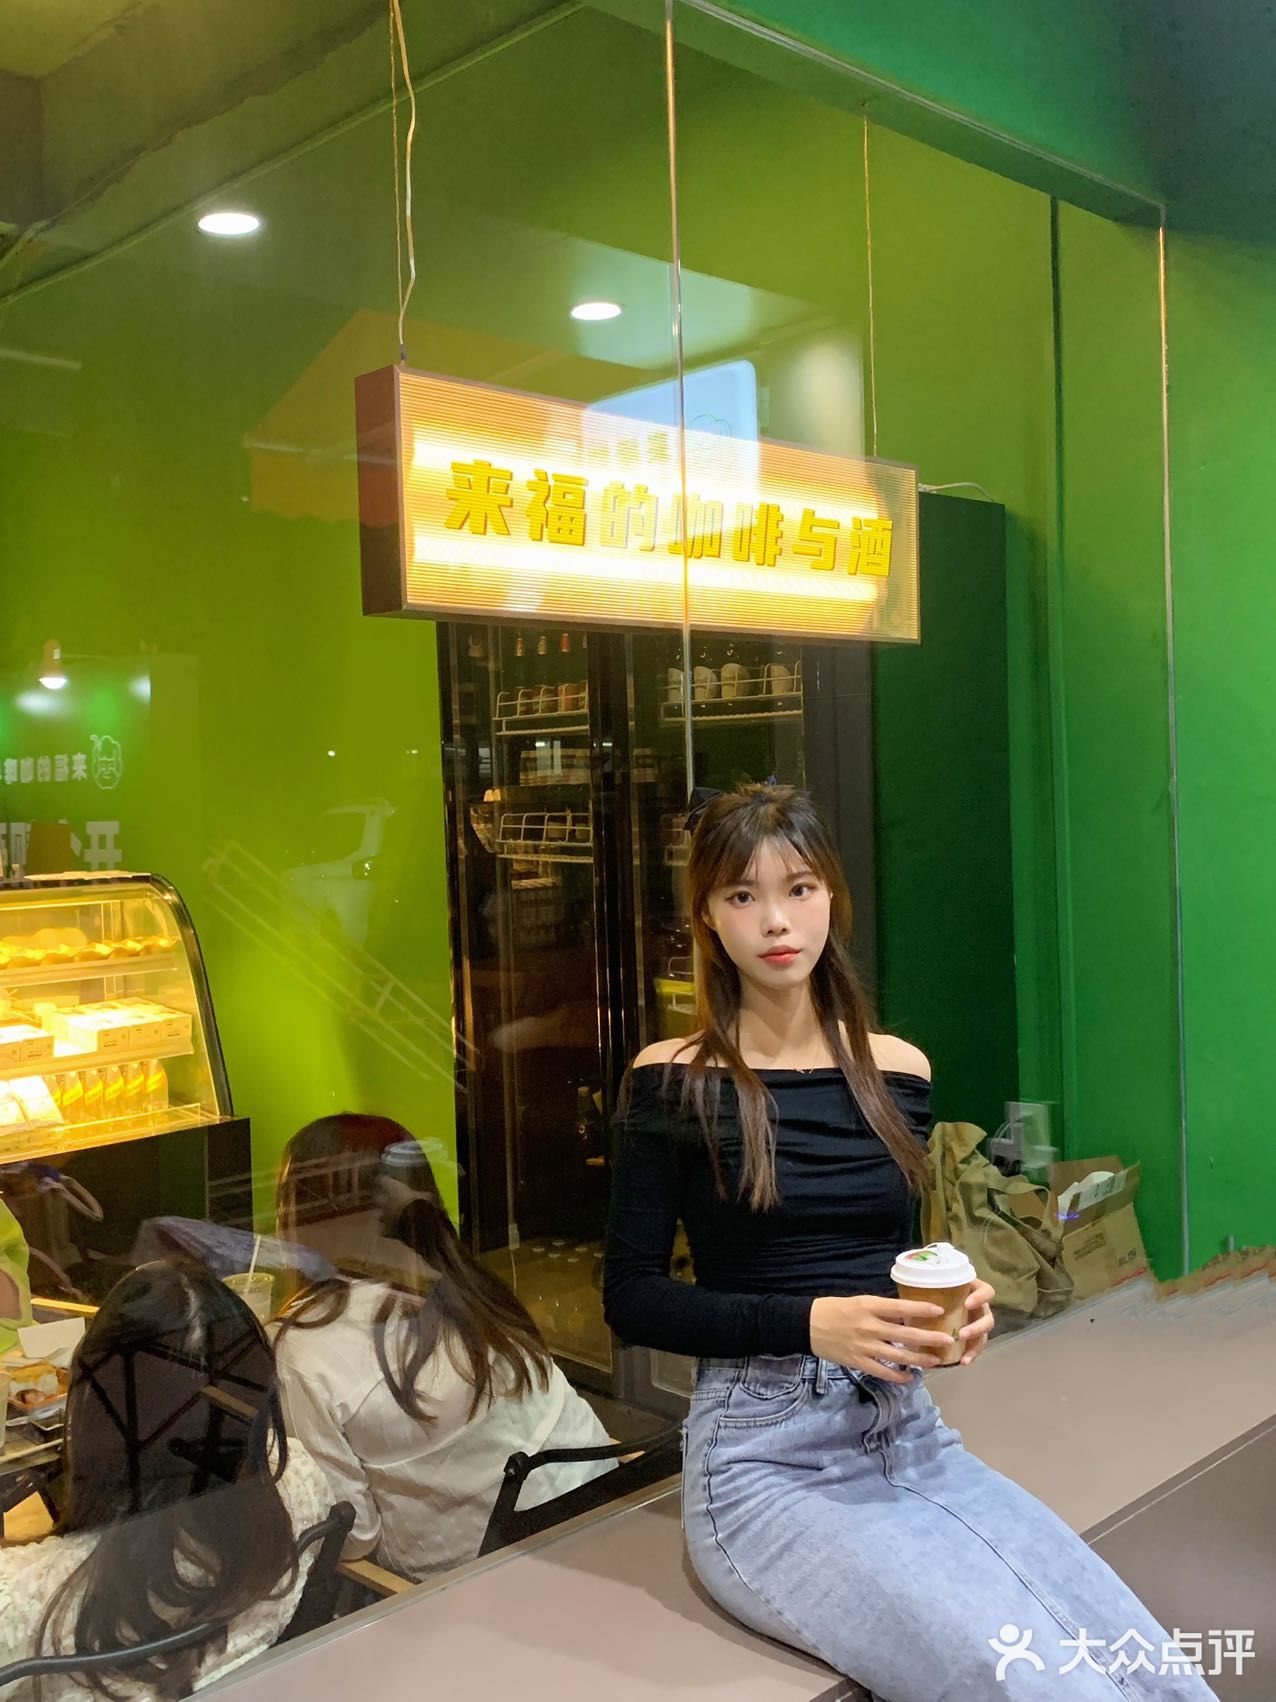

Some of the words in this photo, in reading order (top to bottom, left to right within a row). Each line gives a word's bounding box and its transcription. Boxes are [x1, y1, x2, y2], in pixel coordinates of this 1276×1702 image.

[445, 459, 894, 577] 来福的咖啡与酒
